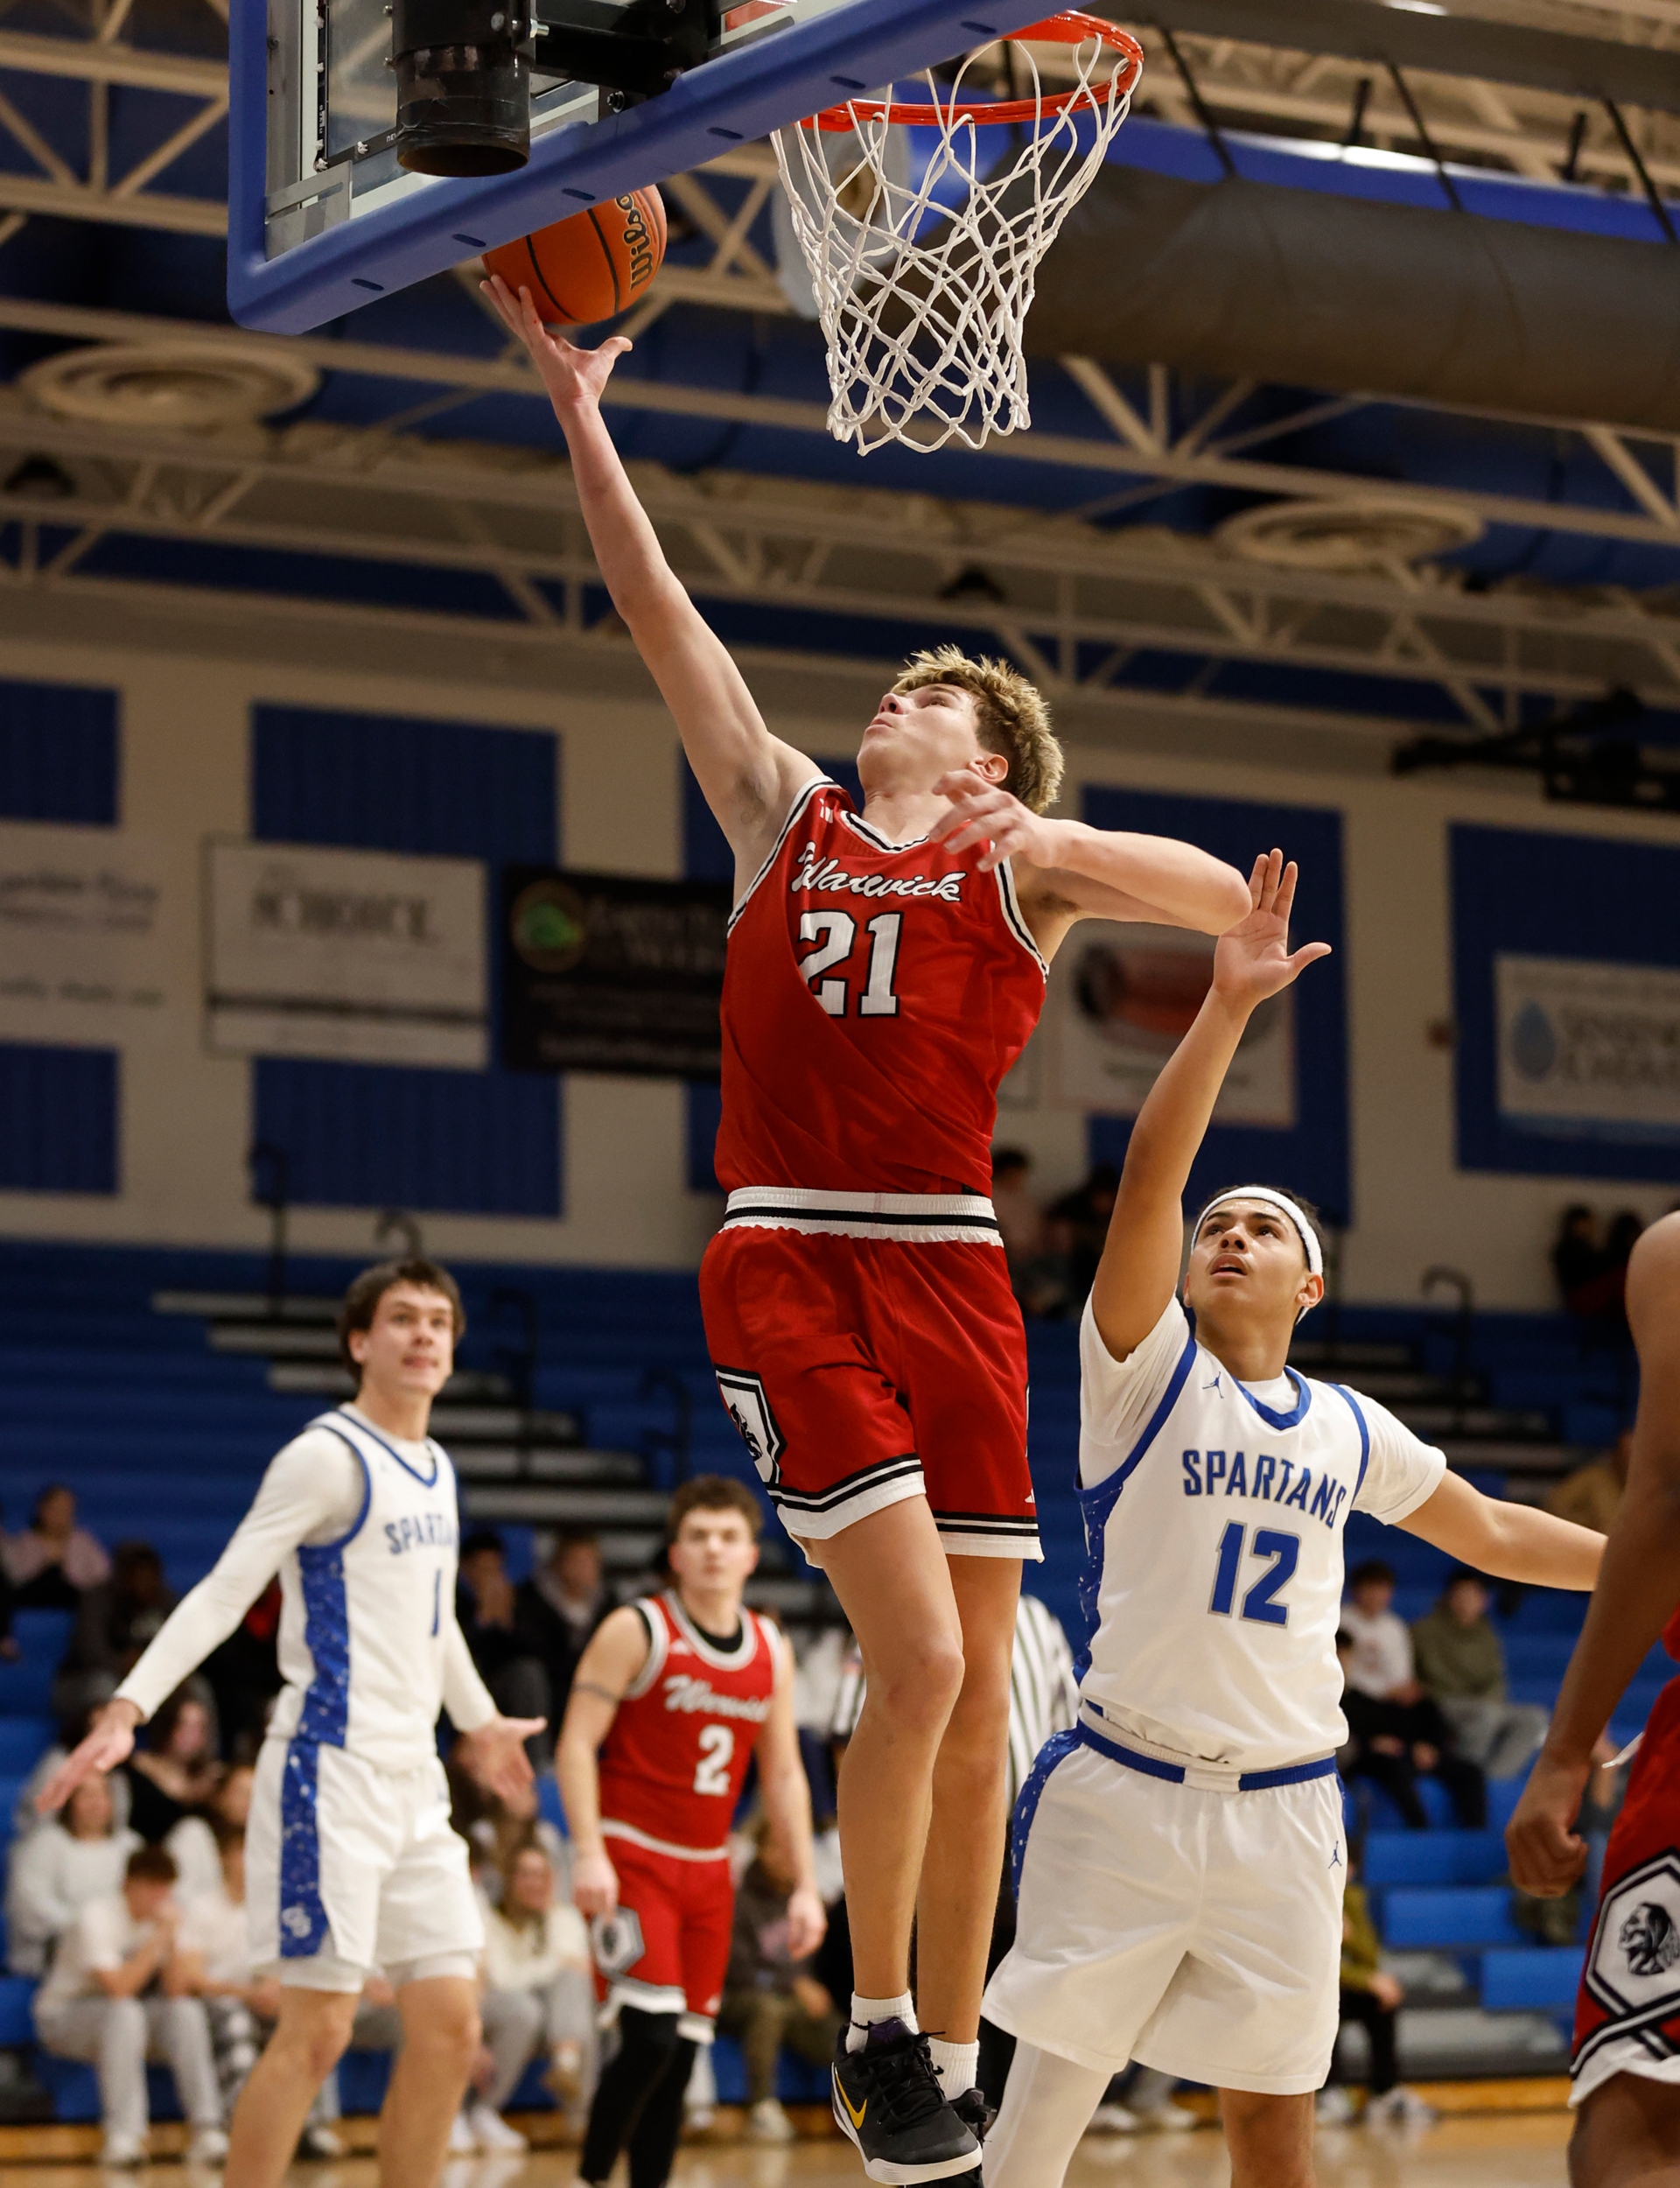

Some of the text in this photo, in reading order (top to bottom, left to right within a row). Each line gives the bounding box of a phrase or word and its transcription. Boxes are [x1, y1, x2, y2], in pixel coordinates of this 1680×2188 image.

[614, 192, 654, 291] Wilso
[791, 840, 967, 902] Warwick
[796, 908, 904, 1019] 21
[1182, 1448, 1348, 1530] SPARTANS
[1207, 1518, 1302, 1630] 12
[692, 1722, 735, 1797] 2
